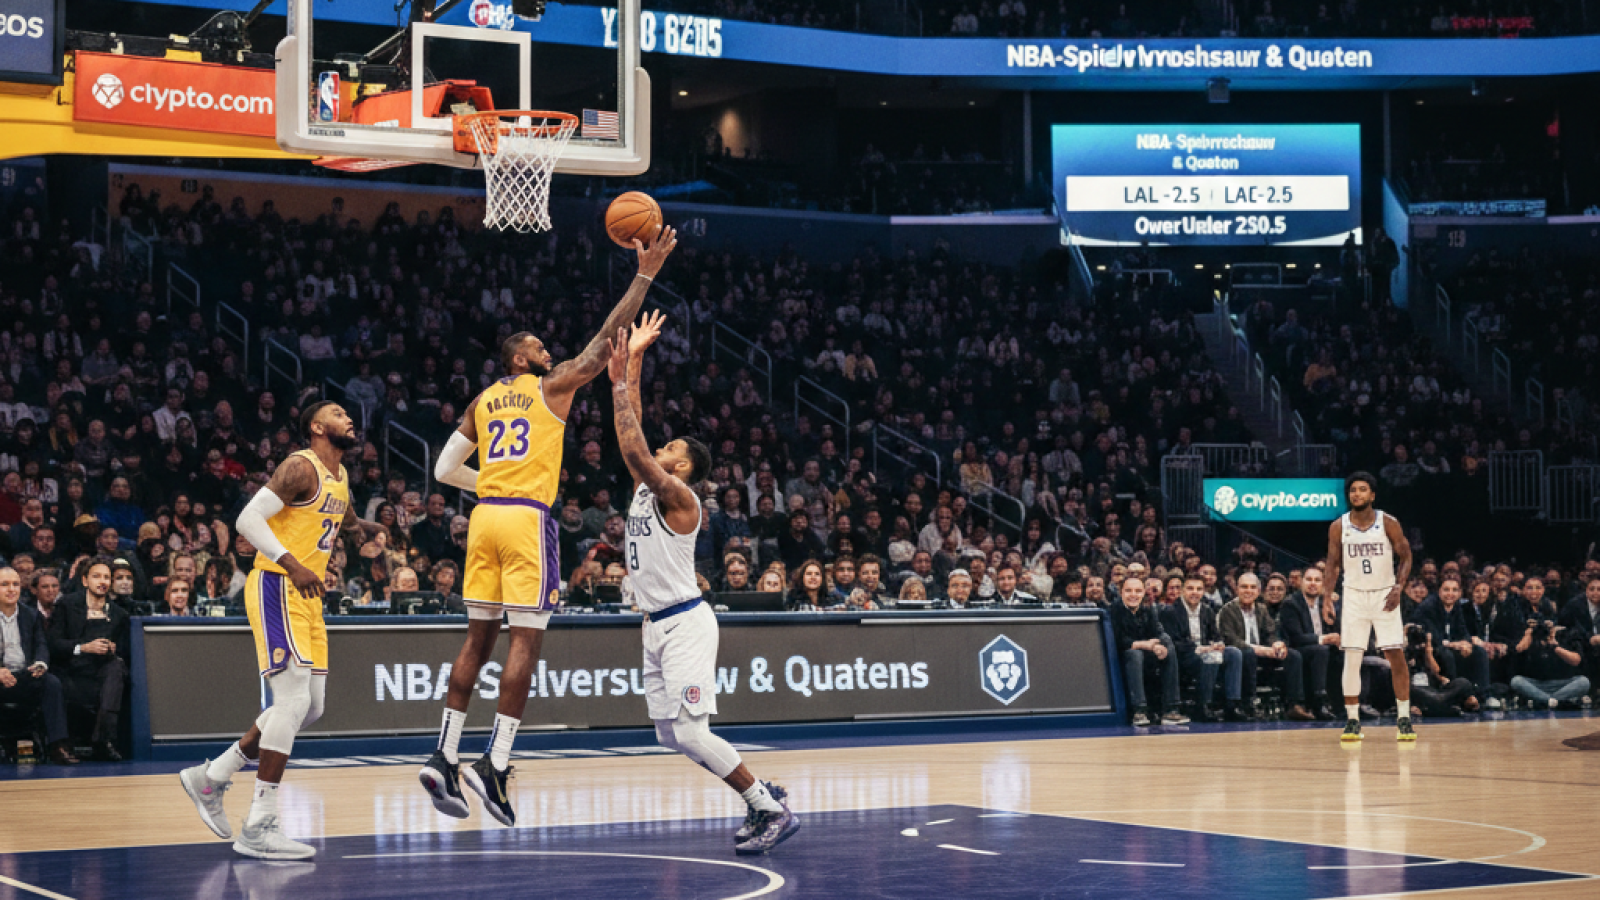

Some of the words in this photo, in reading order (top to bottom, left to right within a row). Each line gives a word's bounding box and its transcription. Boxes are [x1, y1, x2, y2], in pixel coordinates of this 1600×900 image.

[1266, 45, 1283, 68] &
[1124, 186, 1159, 204] LAL
[487, 418, 530, 460] 23
[750, 656, 775, 693] &
[785, 655, 929, 698] Quatens
